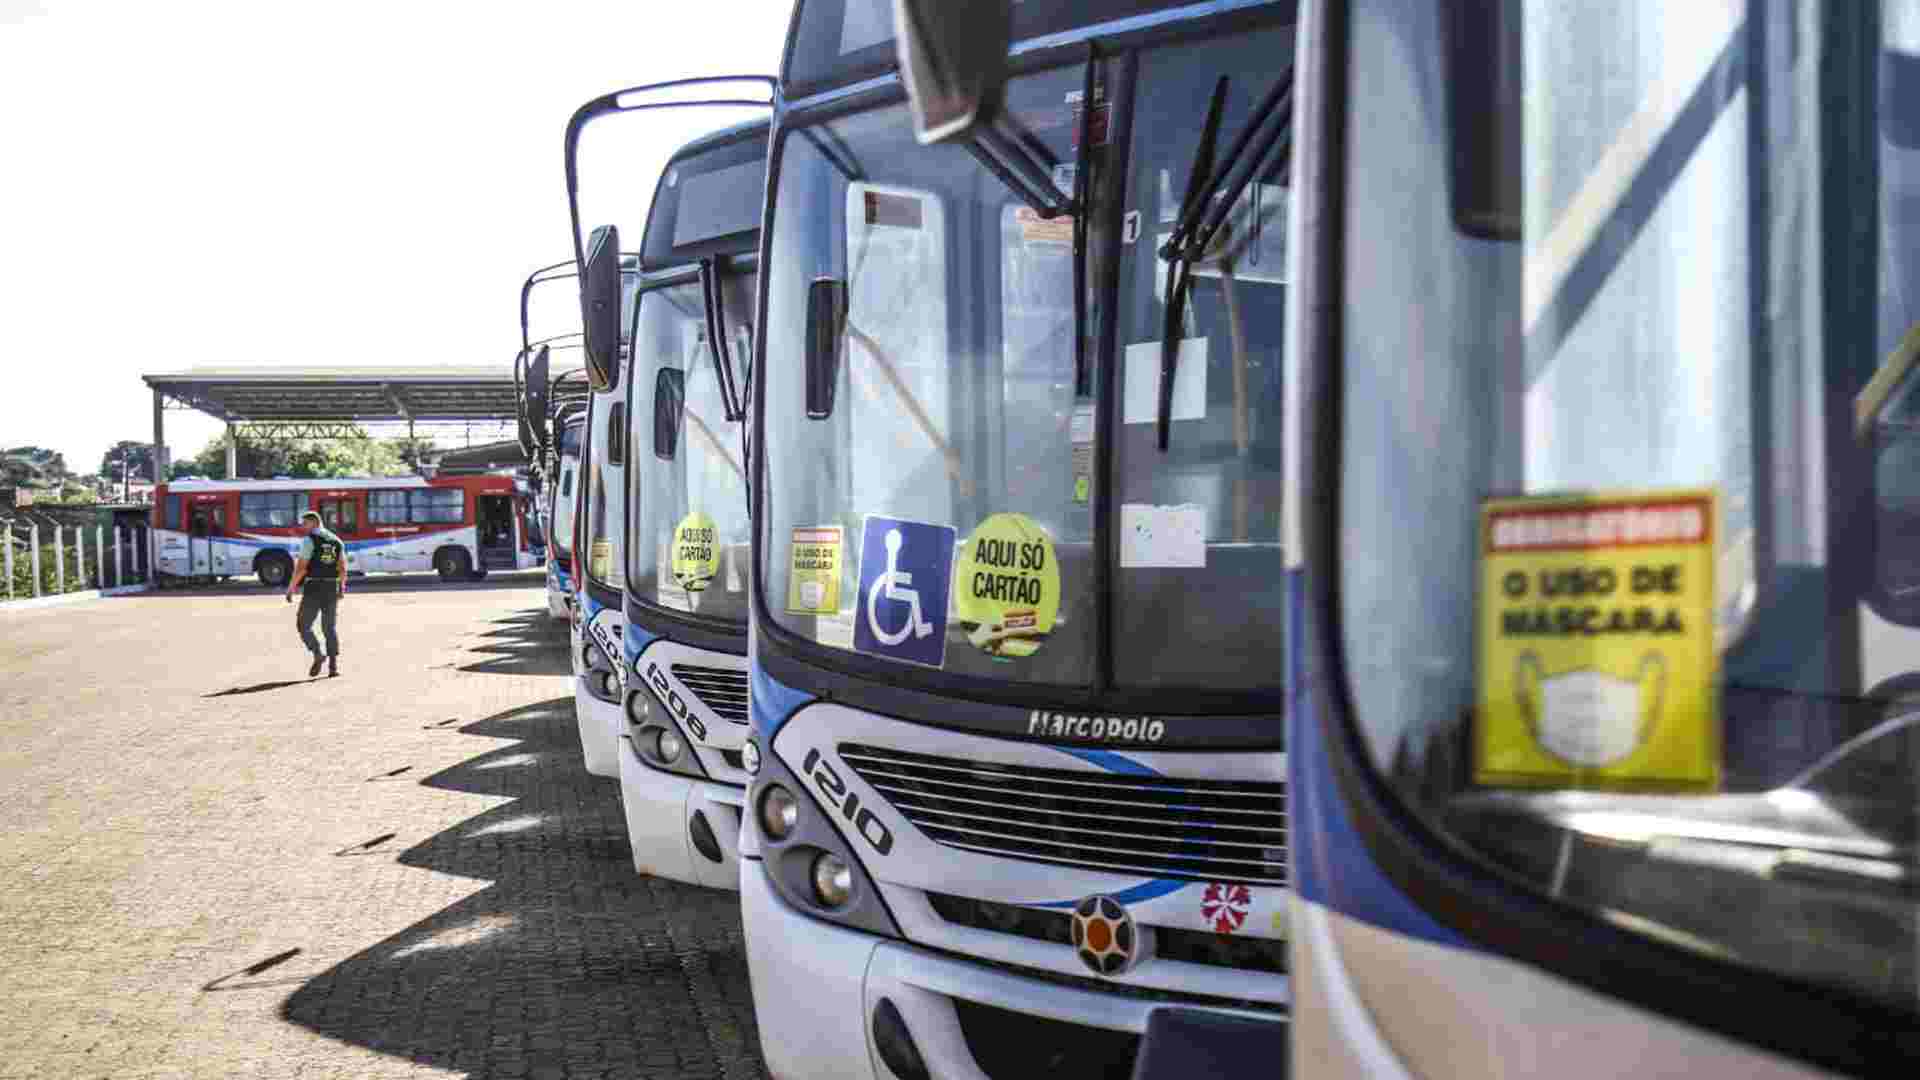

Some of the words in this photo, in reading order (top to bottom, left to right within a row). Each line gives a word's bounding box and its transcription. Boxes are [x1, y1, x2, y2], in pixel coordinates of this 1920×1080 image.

[975, 537, 1016, 568] AQUI
[1020, 537, 1045, 571] SÓ
[973, 571, 1041, 605] CARTÃO
[1503, 569, 1528, 597] O
[1539, 567, 1618, 598] USO
[1631, 564, 1682, 595] DE
[646, 662, 707, 741] 1208
[1027, 709, 1165, 742] Marcopolo
[802, 747, 895, 857] 1210
